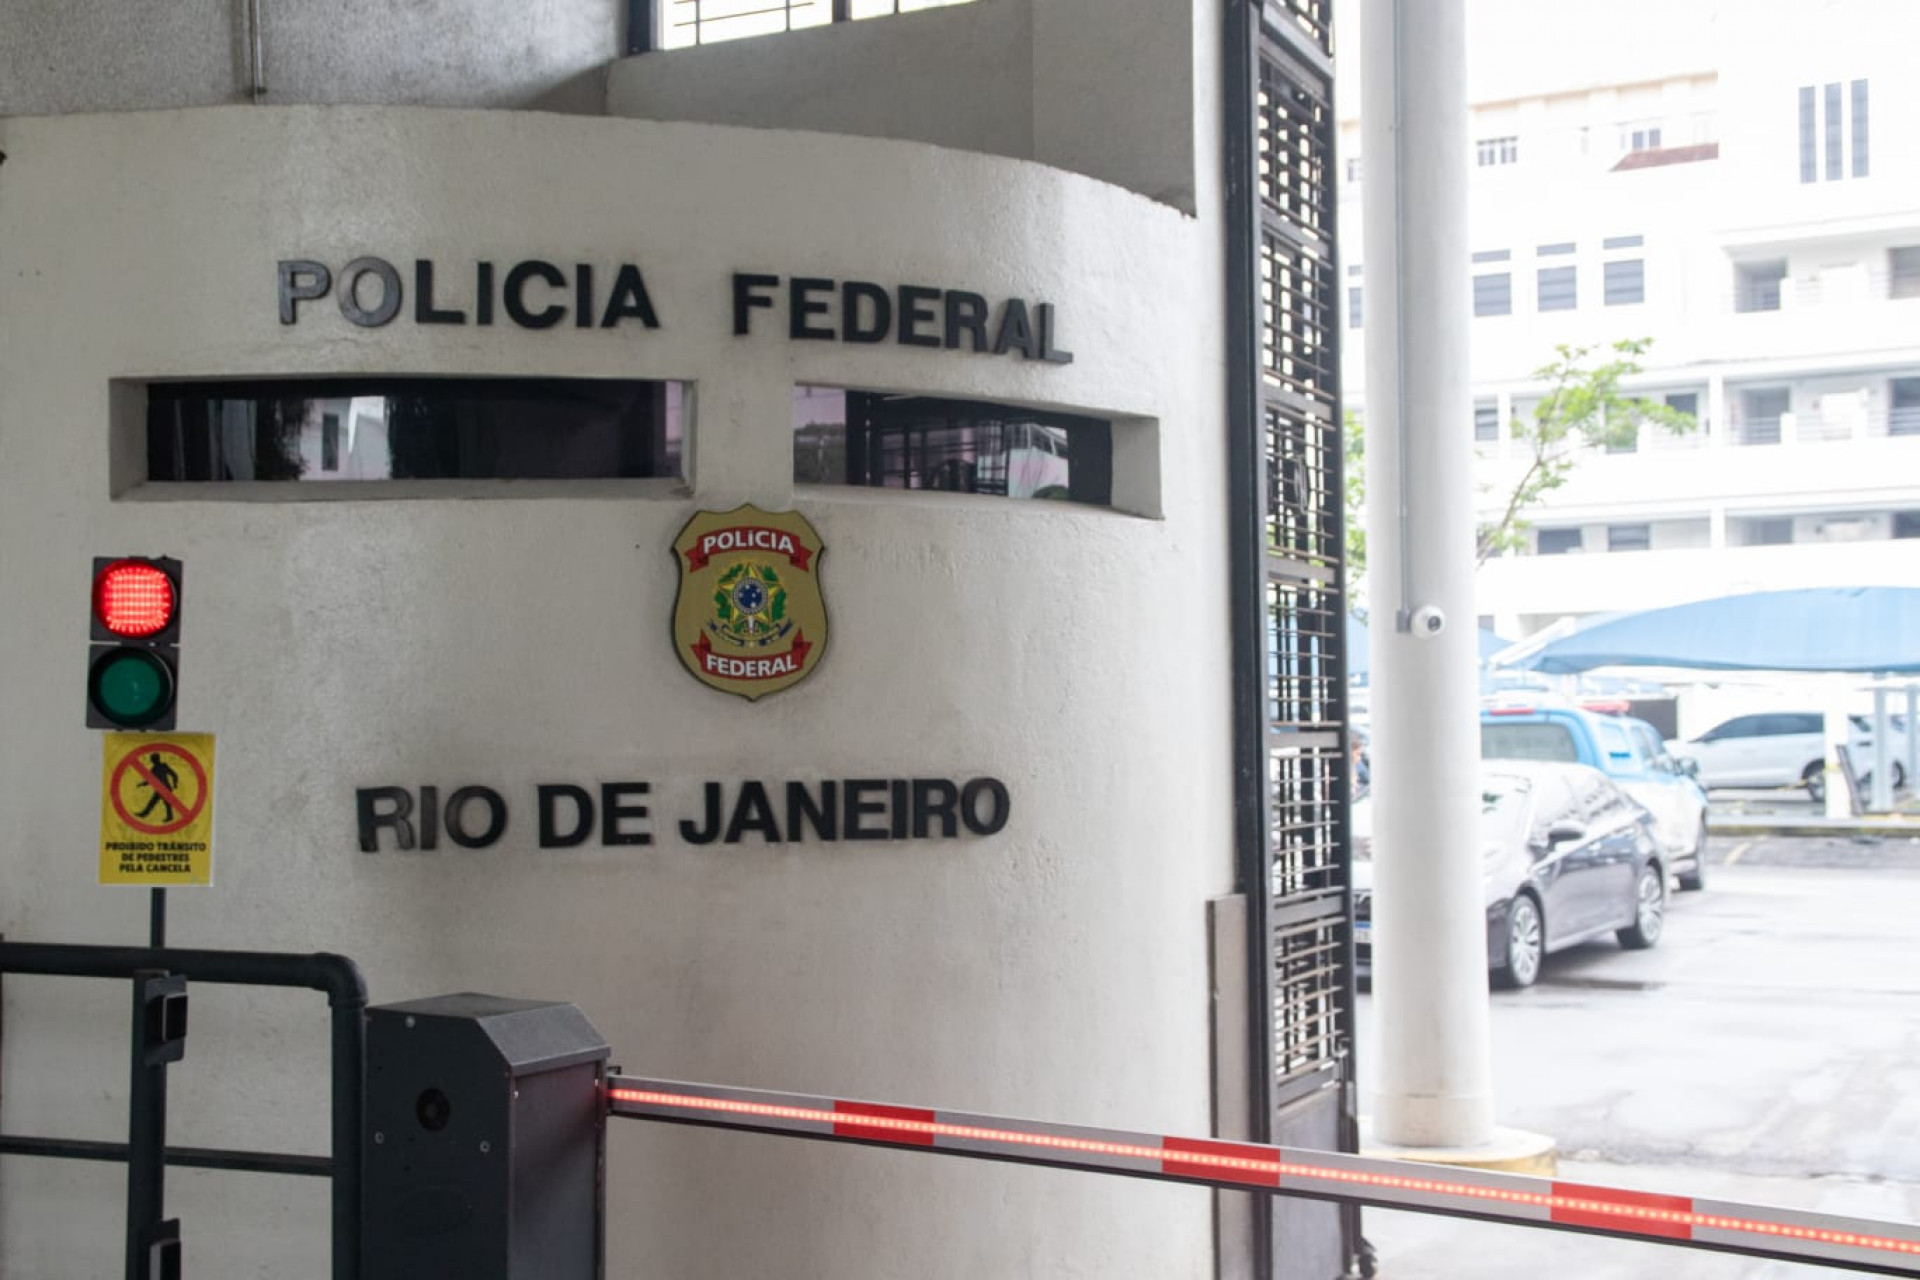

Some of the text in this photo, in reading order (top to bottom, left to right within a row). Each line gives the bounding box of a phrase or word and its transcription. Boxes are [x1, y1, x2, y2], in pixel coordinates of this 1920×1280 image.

[277, 256, 1074, 364] POLICIA FEDERAL
[706, 653, 798, 677] FEDERAL
[356, 777, 1010, 854] RIO DE JANEIRO
[106, 841, 154, 851] PROIBIDO
[121, 853, 189, 862] DE PEDESTRES
[119, 863, 191, 873] PELA CANCELA
